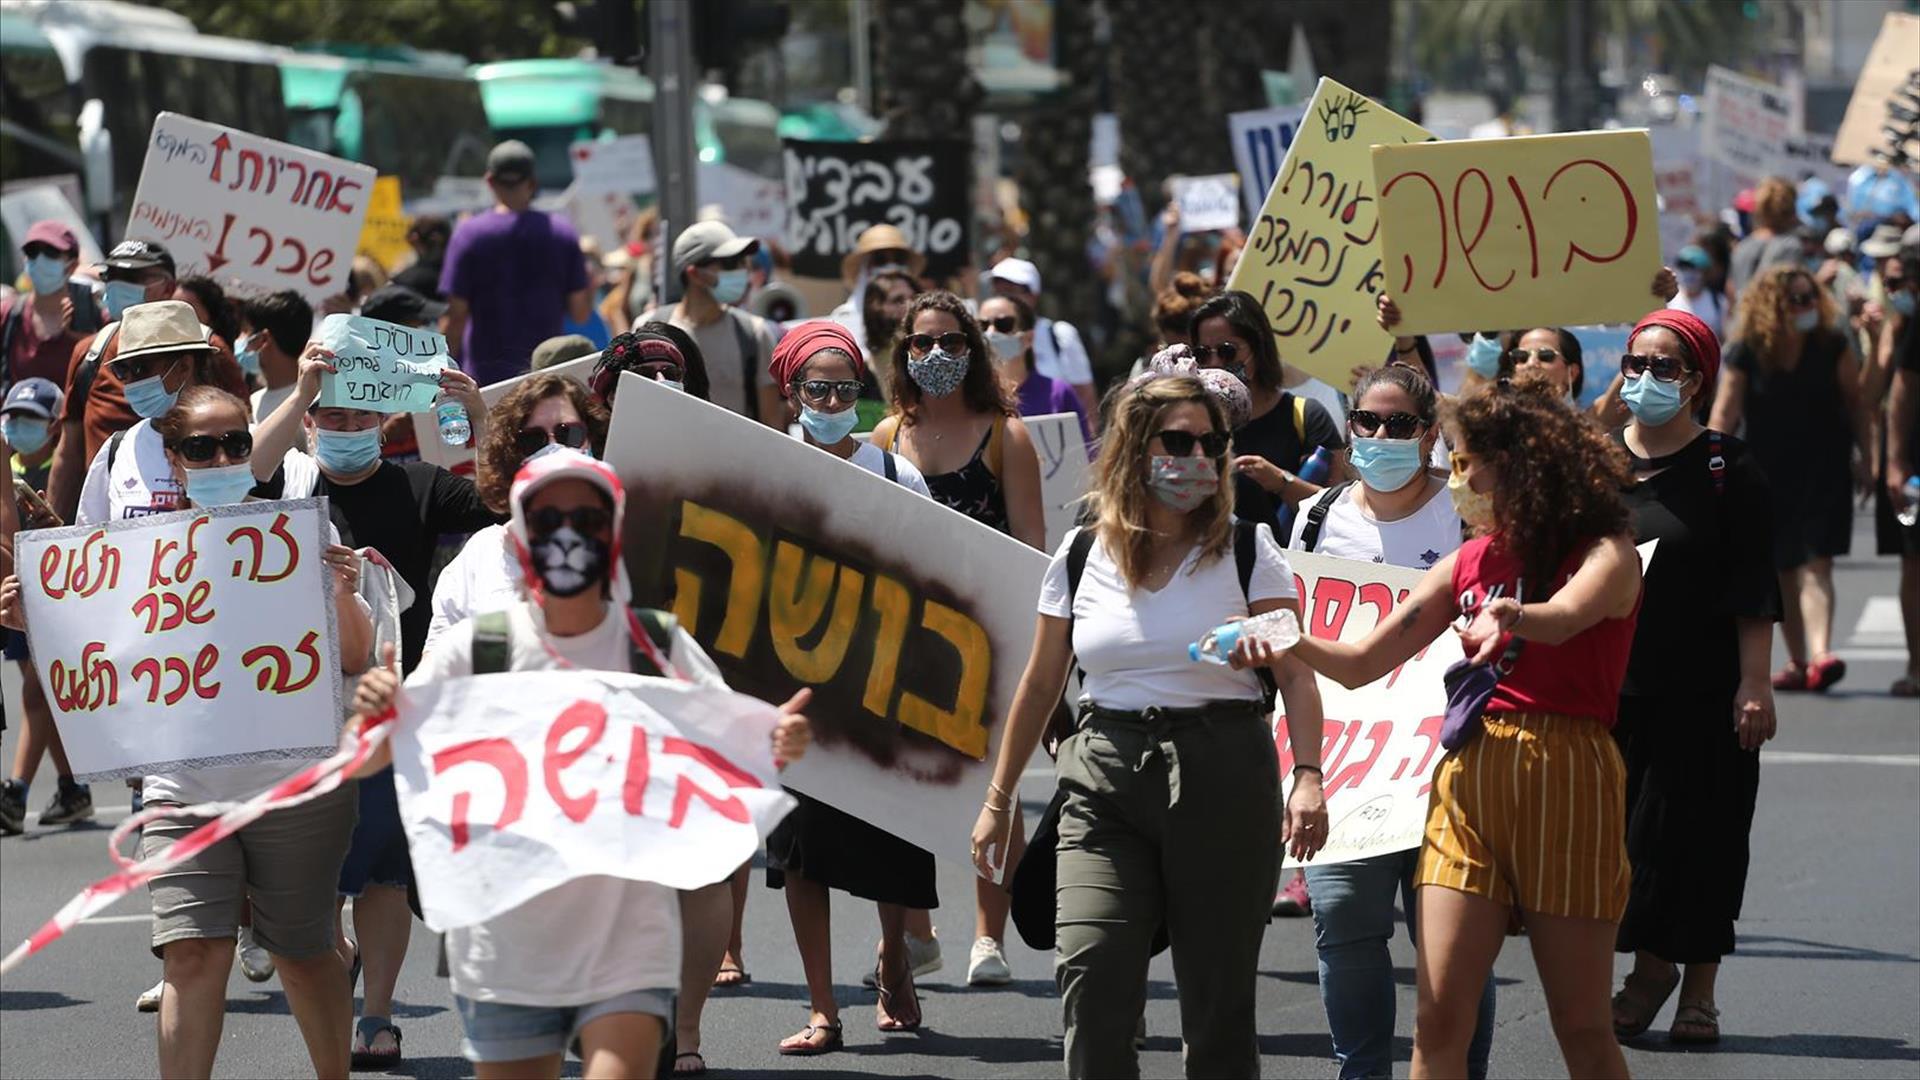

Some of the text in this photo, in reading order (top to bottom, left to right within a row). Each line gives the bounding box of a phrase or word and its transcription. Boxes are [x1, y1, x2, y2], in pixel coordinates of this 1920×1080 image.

[229, 148, 361, 214] אחריות
[248, 227, 334, 286] שכר
[1255, 215, 1349, 287] נחמדה
[1382, 160, 1637, 293] בושה
[39, 513, 299, 599] זה לא תלוש
[131, 581, 215, 634] שכר
[670, 500, 993, 761] בושה
[50, 631, 321, 712] זה שכר תלוש
[433, 700, 763, 853] בושה
